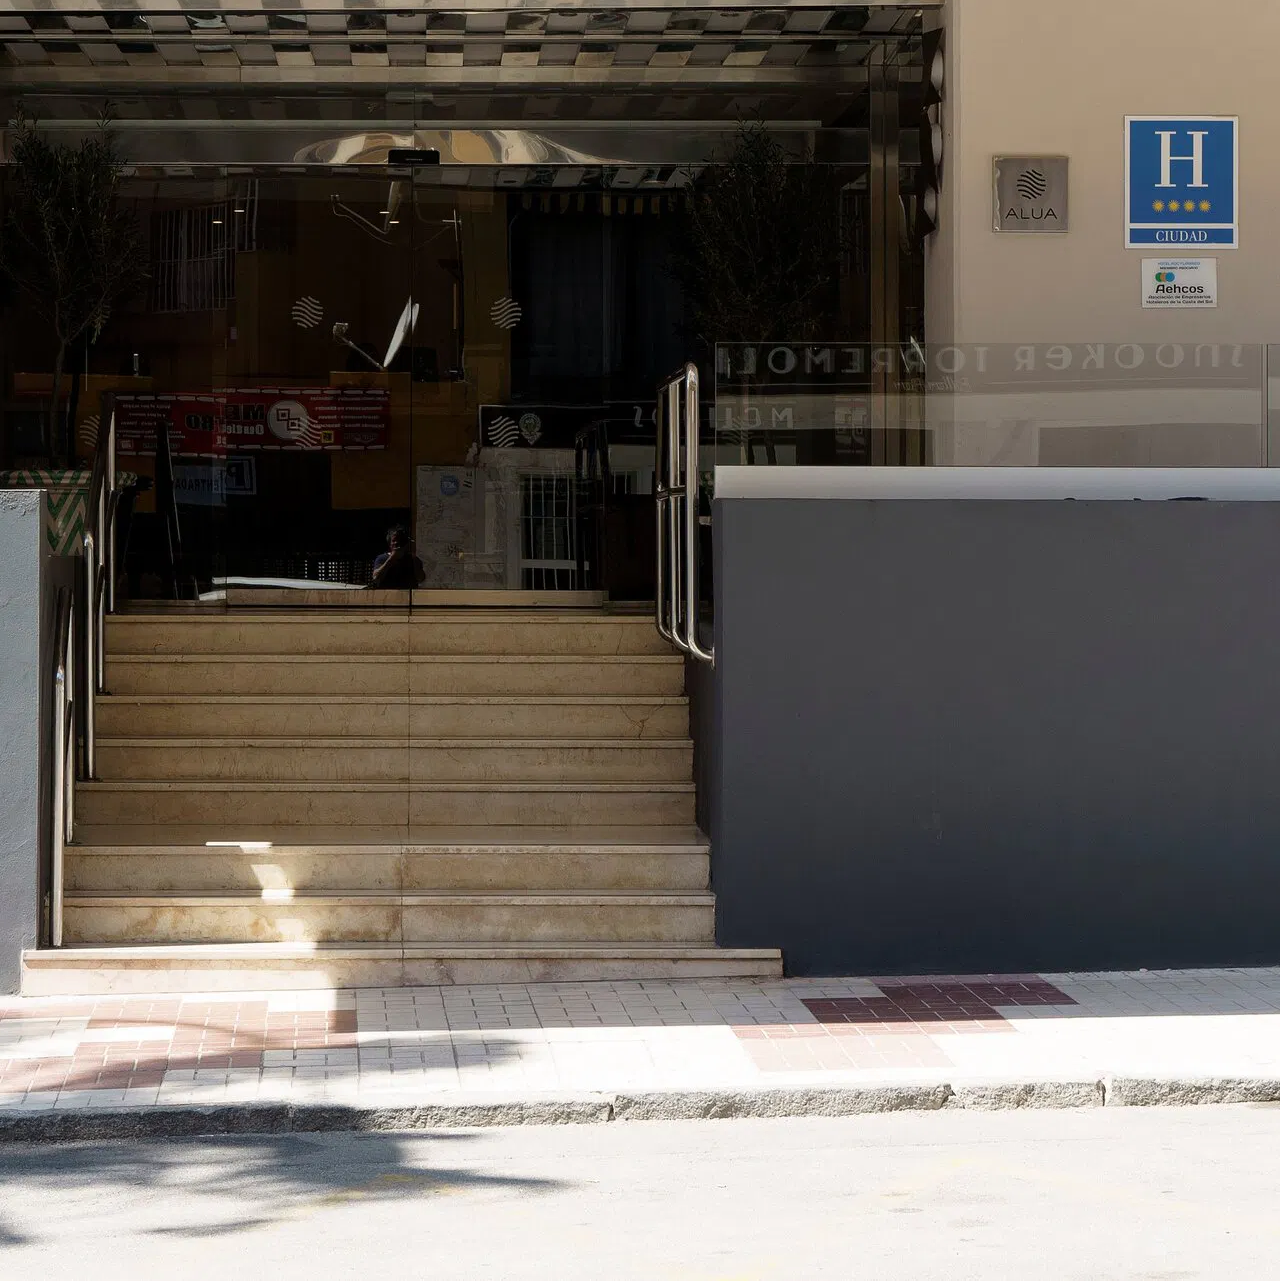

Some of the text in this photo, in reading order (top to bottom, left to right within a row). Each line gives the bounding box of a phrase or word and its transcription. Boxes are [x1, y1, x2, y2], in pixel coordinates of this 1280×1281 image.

[1154, 131, 1209, 188] H
[1005, 207, 1058, 220] ALUA
[1155, 230, 1208, 243] CIUDAD
[1155, 284, 1204, 294] Aehcos
